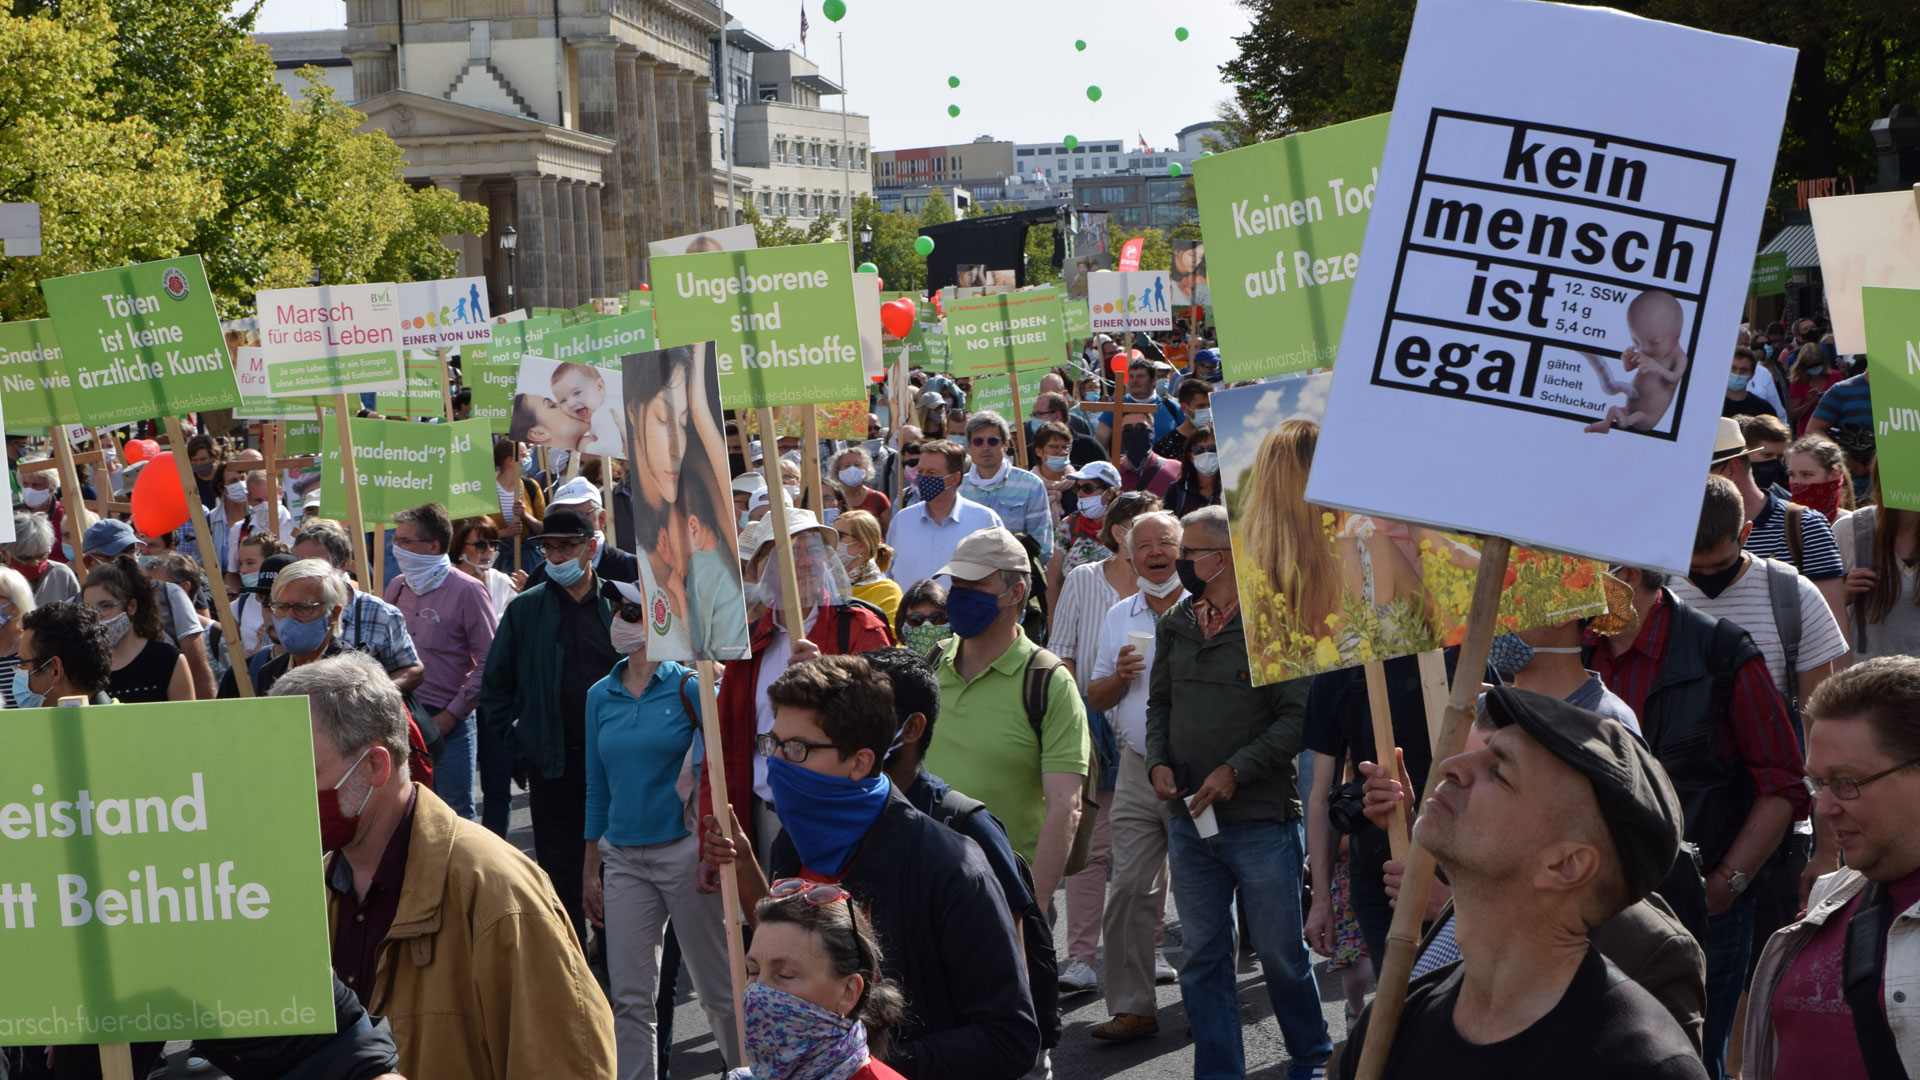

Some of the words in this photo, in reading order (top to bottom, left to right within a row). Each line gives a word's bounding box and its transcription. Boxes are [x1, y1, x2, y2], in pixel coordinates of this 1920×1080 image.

[1502, 127, 1648, 202] kein
[1231, 193, 1323, 239] Keinen
[1422, 197, 1695, 284] mensch
[676, 266, 828, 303] Ungeborene
[1244, 250, 1287, 299] auf
[1293, 250, 1360, 289] Reze
[1465, 260, 1556, 329] ist
[1565, 282, 1585, 296] 12.
[1590, 286, 1627, 304] SSW
[102, 294, 161, 319] Töten
[277, 302, 354, 324] Marsch
[730, 301, 782, 333] sind
[1561, 301, 1578, 314] 14
[1582, 306, 1592, 319] g
[954, 324, 977, 336] NO
[981, 315, 1047, 333] CHILDREN
[1094, 319, 1123, 328] EINER
[1126, 318, 1147, 326] VON
[1150, 317, 1171, 326] UNS
[1555, 318, 1578, 334] 5,4
[1582, 327, 1606, 339] cm
[98, 328, 124, 352] ist
[126, 321, 183, 349] keine
[268, 329, 289, 344] für
[293, 328, 322, 343] das
[327, 325, 393, 346] Leben
[403, 334, 437, 345] EINER
[439, 332, 464, 342] VON
[467, 329, 490, 340] UNS
[514, 336, 522, 344] a
[553, 328, 646, 359] Inklusion
[966, 338, 989, 350] NO
[993, 331, 1047, 347] FUTURE!
[492, 352, 510, 363] not
[512, 351, 520, 359] a
[740, 335, 857, 370] Rohstoffe
[78, 354, 164, 389] ärztliche
[166, 348, 224, 376] Kunst
[306, 363, 328, 373] Leben
[360, 357, 386, 368] Europa
[1394, 336, 1544, 397] egal
[1547, 360, 1581, 373] gähnt
[3, 374, 36, 393] Nie
[39, 371, 71, 389] wie
[241, 373, 256, 384] für
[295, 372, 335, 387] Abtreibung
[336, 372, 350, 381] und
[1543, 374, 1583, 390] lächelt
[401, 390, 441, 398] ZUKUNFT!
[977, 383, 1031, 399] Abtreibng
[1540, 391, 1607, 412] Schluckauf
[474, 404, 507, 417] keine
[290, 424, 305, 436] auf
[329, 441, 446, 464] „nadentod“?
[341, 467, 368, 485] ie
[373, 471, 433, 490] wieder!
[449, 480, 482, 495] ene
[0, 773, 208, 839] eistand
[57, 861, 271, 927] Beihilfe
